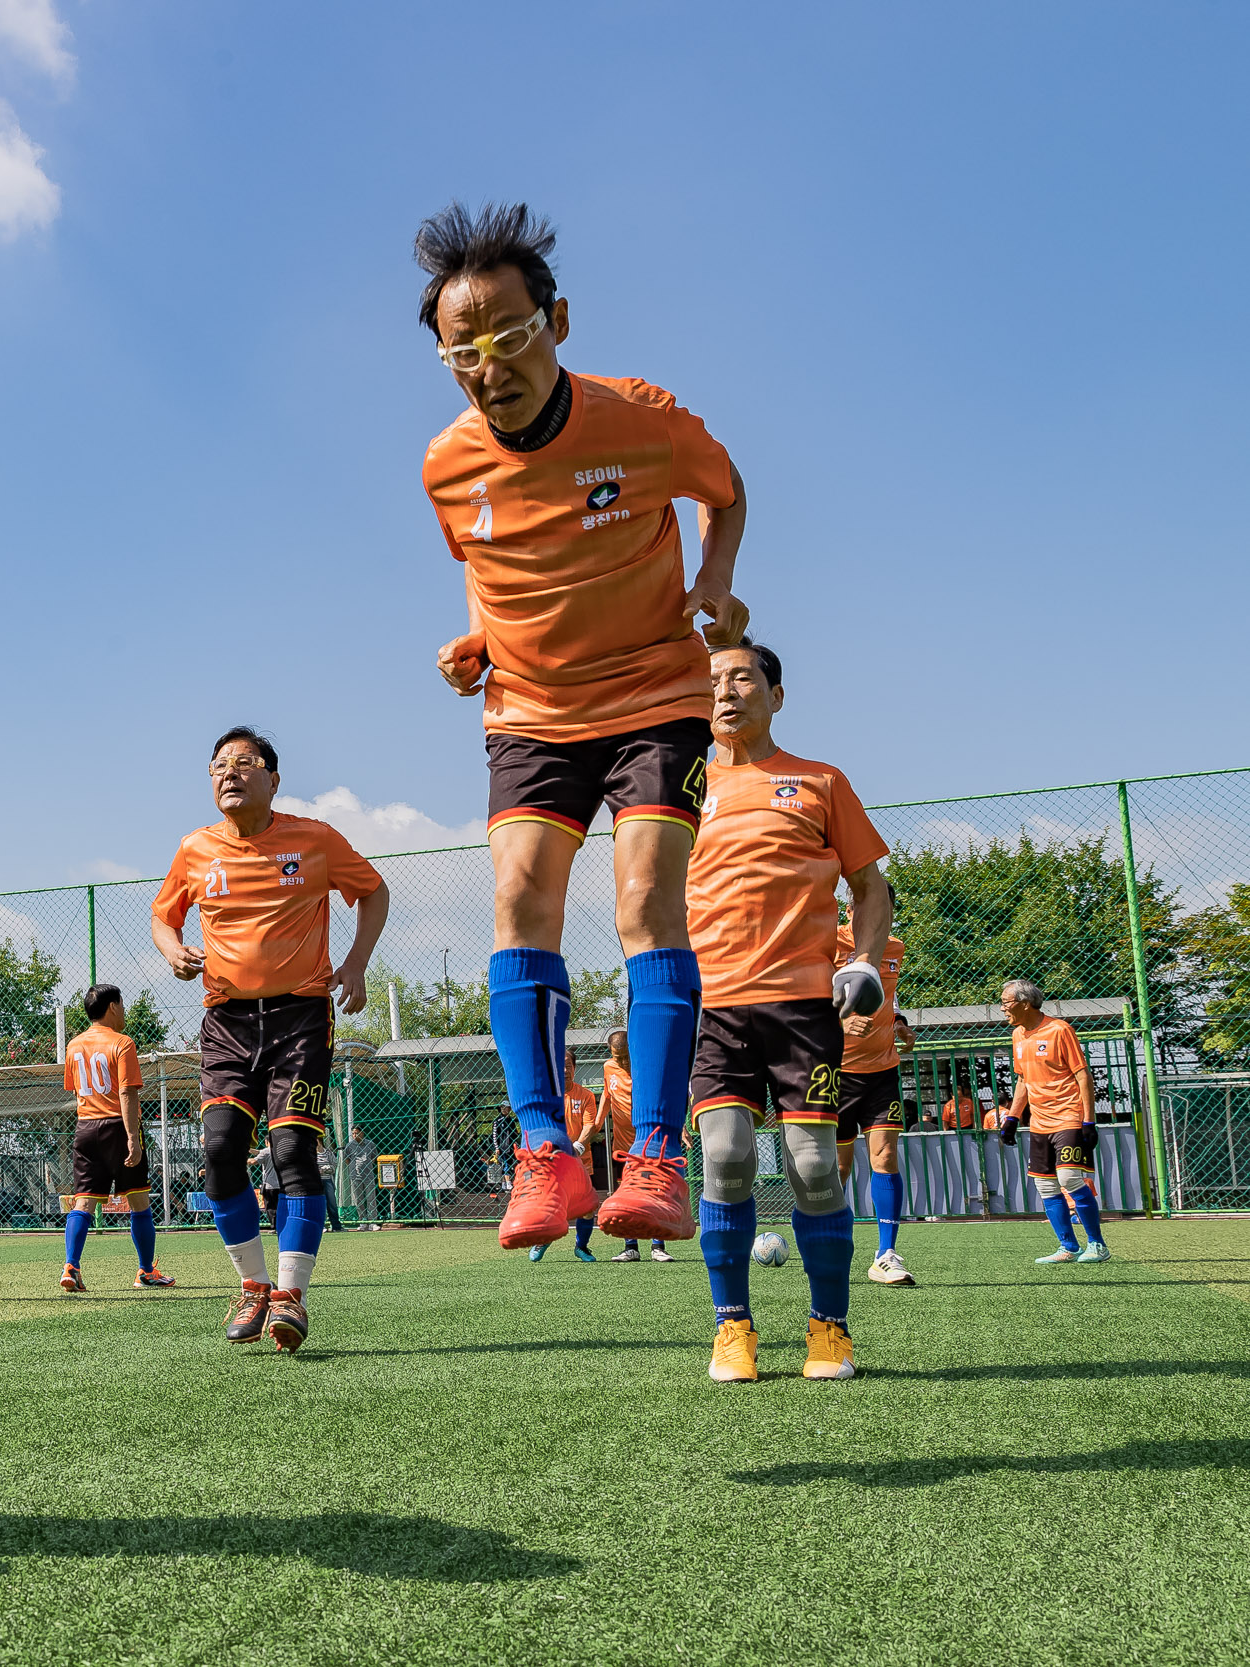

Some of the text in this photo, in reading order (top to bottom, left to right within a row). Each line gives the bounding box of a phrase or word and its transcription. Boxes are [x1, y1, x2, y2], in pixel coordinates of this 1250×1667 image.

[574, 464, 626, 486] SEOUL
[470, 504, 493, 542] 4
[682, 756, 705, 808] 4
[769, 776, 803, 787] SEOUL
[276, 852, 303, 862] SEOUL
[205, 869, 230, 898] 21
[279, 876, 305, 886] 광진70
[73, 1051, 112, 1097] 10
[286, 1080, 323, 1115] 21
[1060, 1145, 1081, 1163] 30
